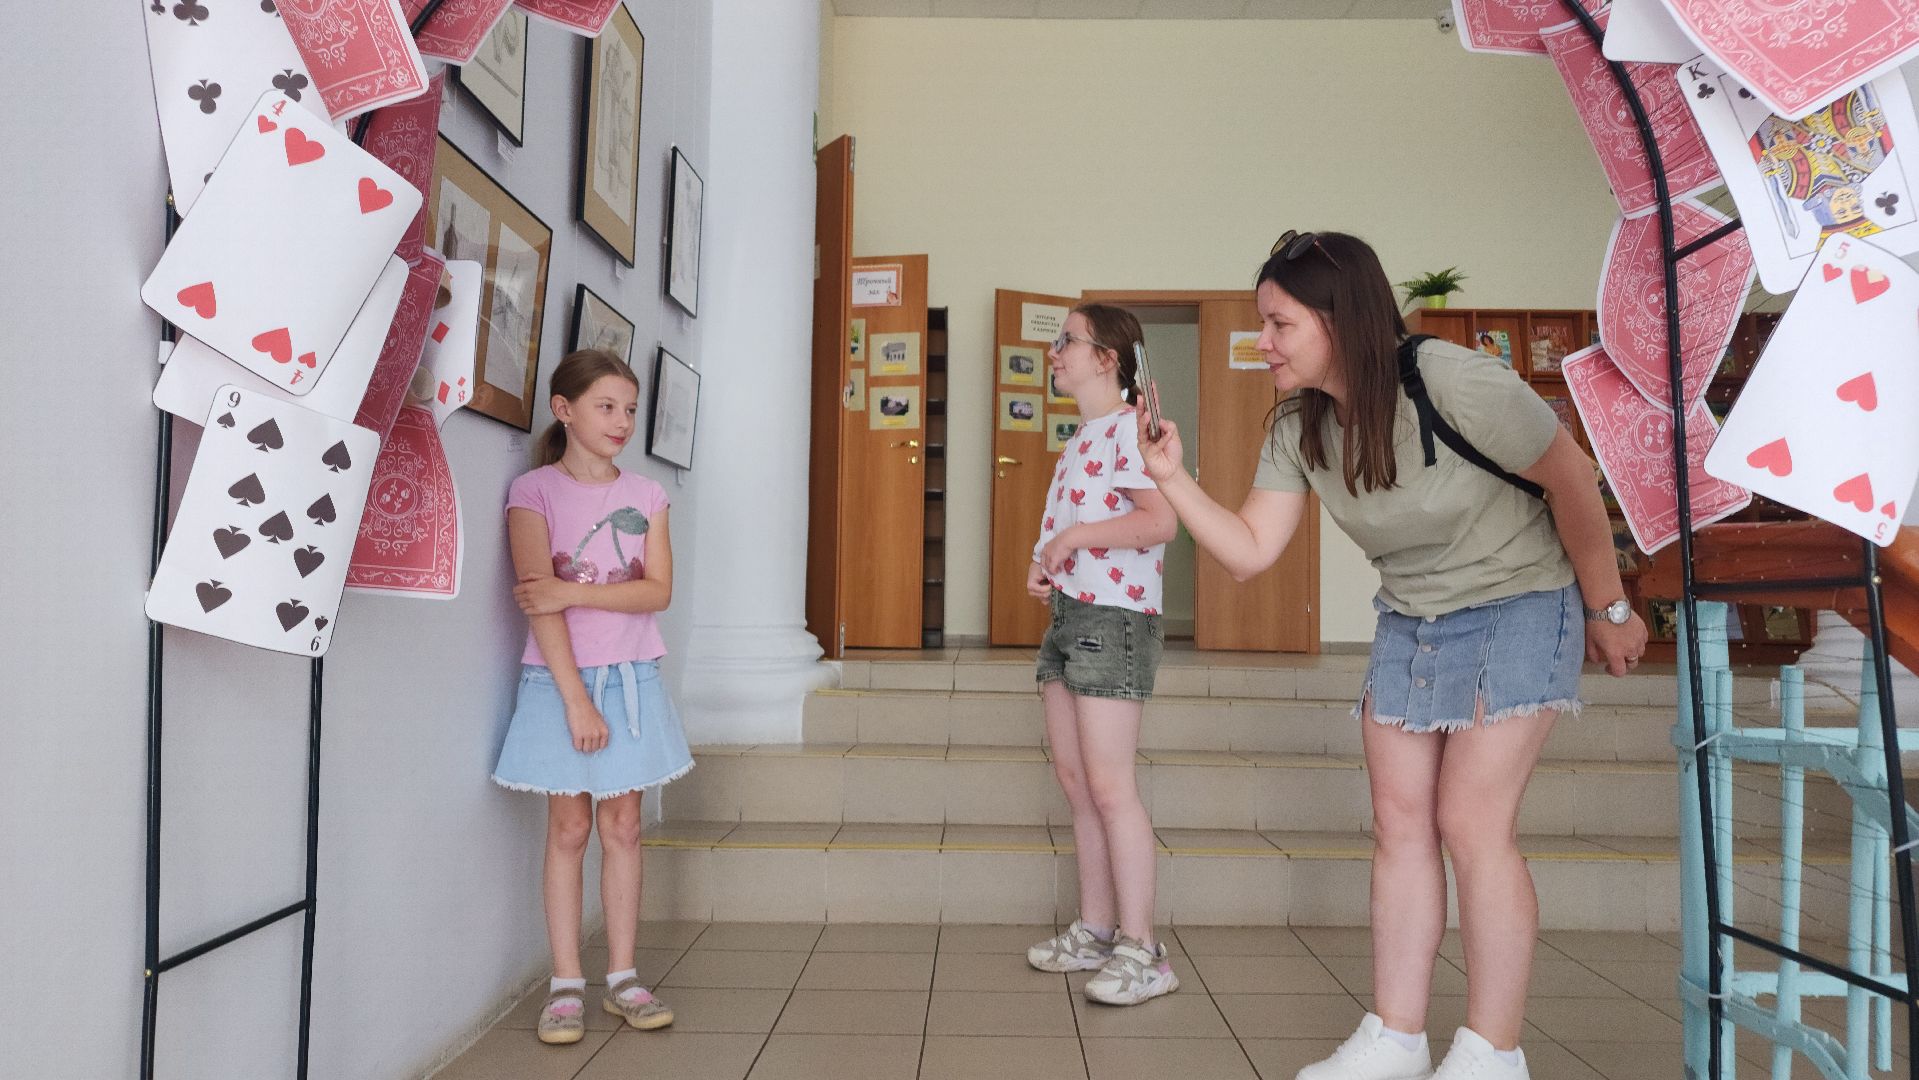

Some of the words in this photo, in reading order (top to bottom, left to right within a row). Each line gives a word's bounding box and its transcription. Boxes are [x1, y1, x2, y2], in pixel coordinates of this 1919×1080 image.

[1686, 61, 1710, 82] K
[272, 99, 288, 117] 4
[1834, 241, 1851, 260] 5
[290, 368, 304, 385] 4
[228, 391, 241, 408] 9
[1874, 521, 1888, 540] 5
